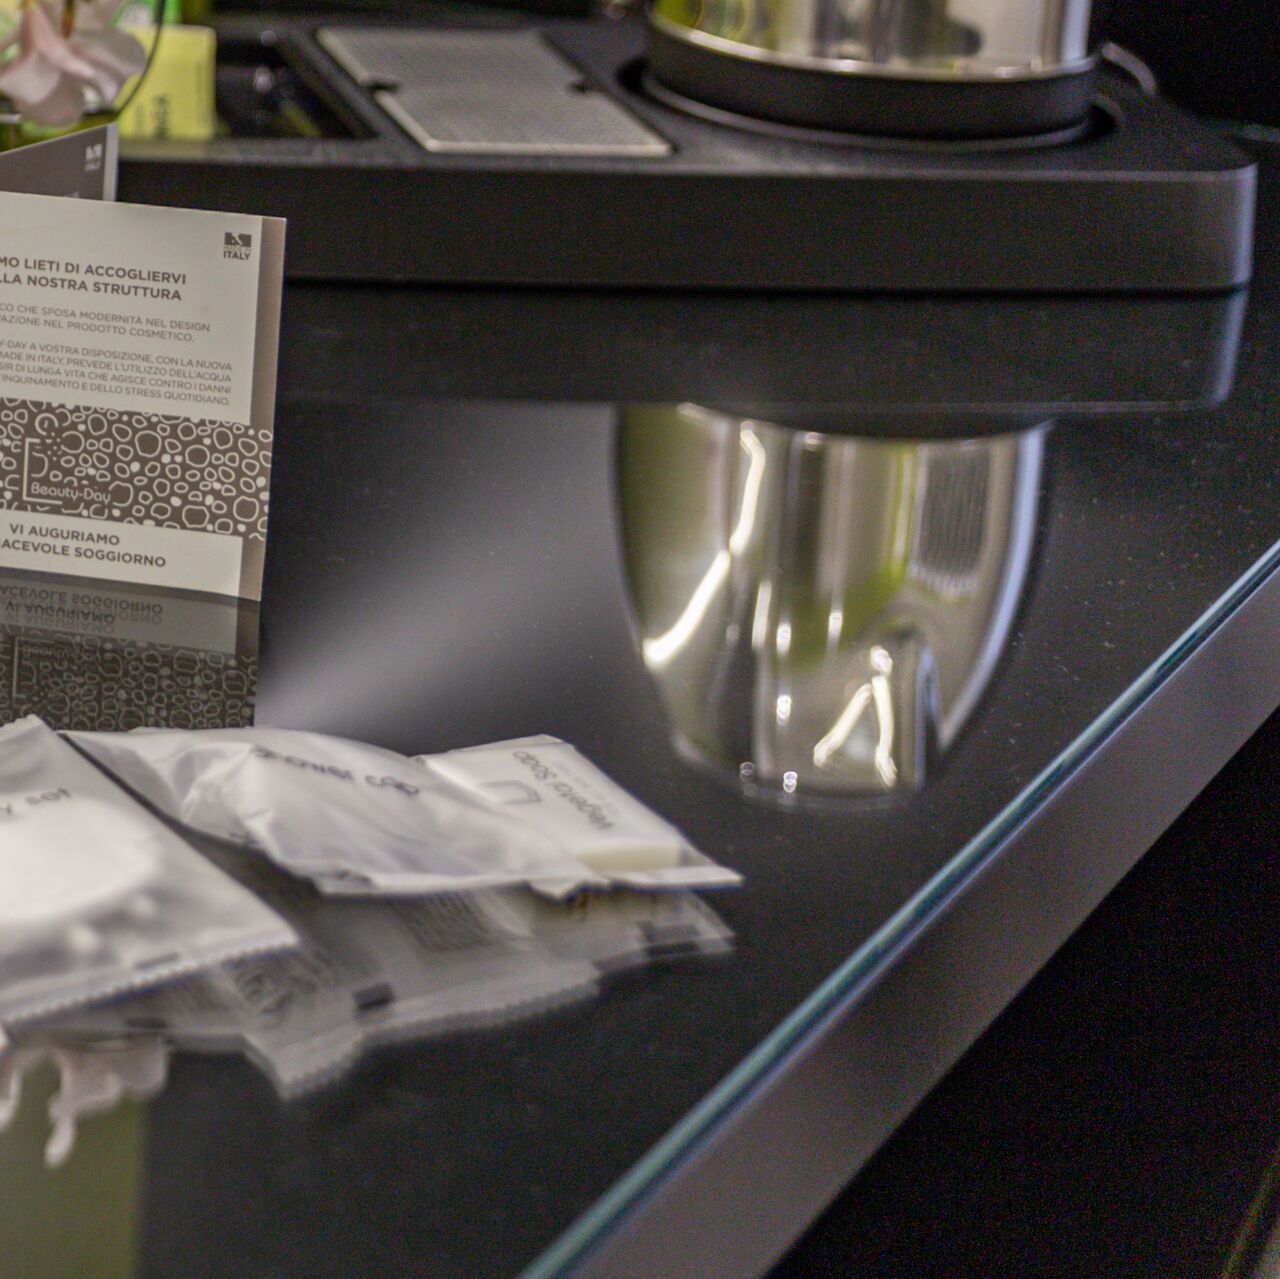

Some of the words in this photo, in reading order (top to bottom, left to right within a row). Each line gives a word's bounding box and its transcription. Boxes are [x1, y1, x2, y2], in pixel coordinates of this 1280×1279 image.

[224, 250, 250, 260] ITALY
[24, 258, 60, 272] LIETI
[65, 262, 80, 274] DI
[84, 264, 186, 285] ACCOGLIERVI
[27, 275, 88, 291] NOSTRA
[93, 281, 181, 301] STRUTTURA
[17, 304, 38, 314] CHE
[41, 306, 76, 318] SPOSA
[80, 310, 142, 325] MODERNITÀ
[146, 318, 166, 328] NEL
[170, 320, 210, 332] DESIGN
[44, 319, 64, 328] NEL
[67, 320, 126, 335] PRODOTTO
[129, 327, 194, 342] COSMETICO.
[26, 354, 36, 362] IN
[66, 358, 112, 370] PREVEDE
[114, 362, 167, 376] L'UTILIZZO
[169, 368, 232, 382] DELL'ACQUA
[30, 342, 37, 350] A
[39, 344, 80, 355] VOSTRA
[156, 356, 178, 366] CON
[180, 359, 194, 367] LA
[196, 360, 232, 371] NUOVA
[15, 364, 25, 372] DI
[27, 366, 61, 376] LUNGA
[64, 370, 86, 378] VITA
[88, 371, 108, 380] CHE
[111, 374, 146, 385] AGISCE
[148, 378, 192, 390] CONTRO
[198, 383, 232, 394] DANNI
[82, 382, 88, 390] E
[90, 383, 123, 394] DELLO
[124, 386, 161, 398] STRESS
[163, 391, 230, 406] QUOTIDIANO.
[30, 481, 111, 504] Beauty-Day
[10, 522, 24, 535] VI
[28, 526, 120, 546] AUGURIAMO
[74, 546, 166, 568] SOGGIORNO
